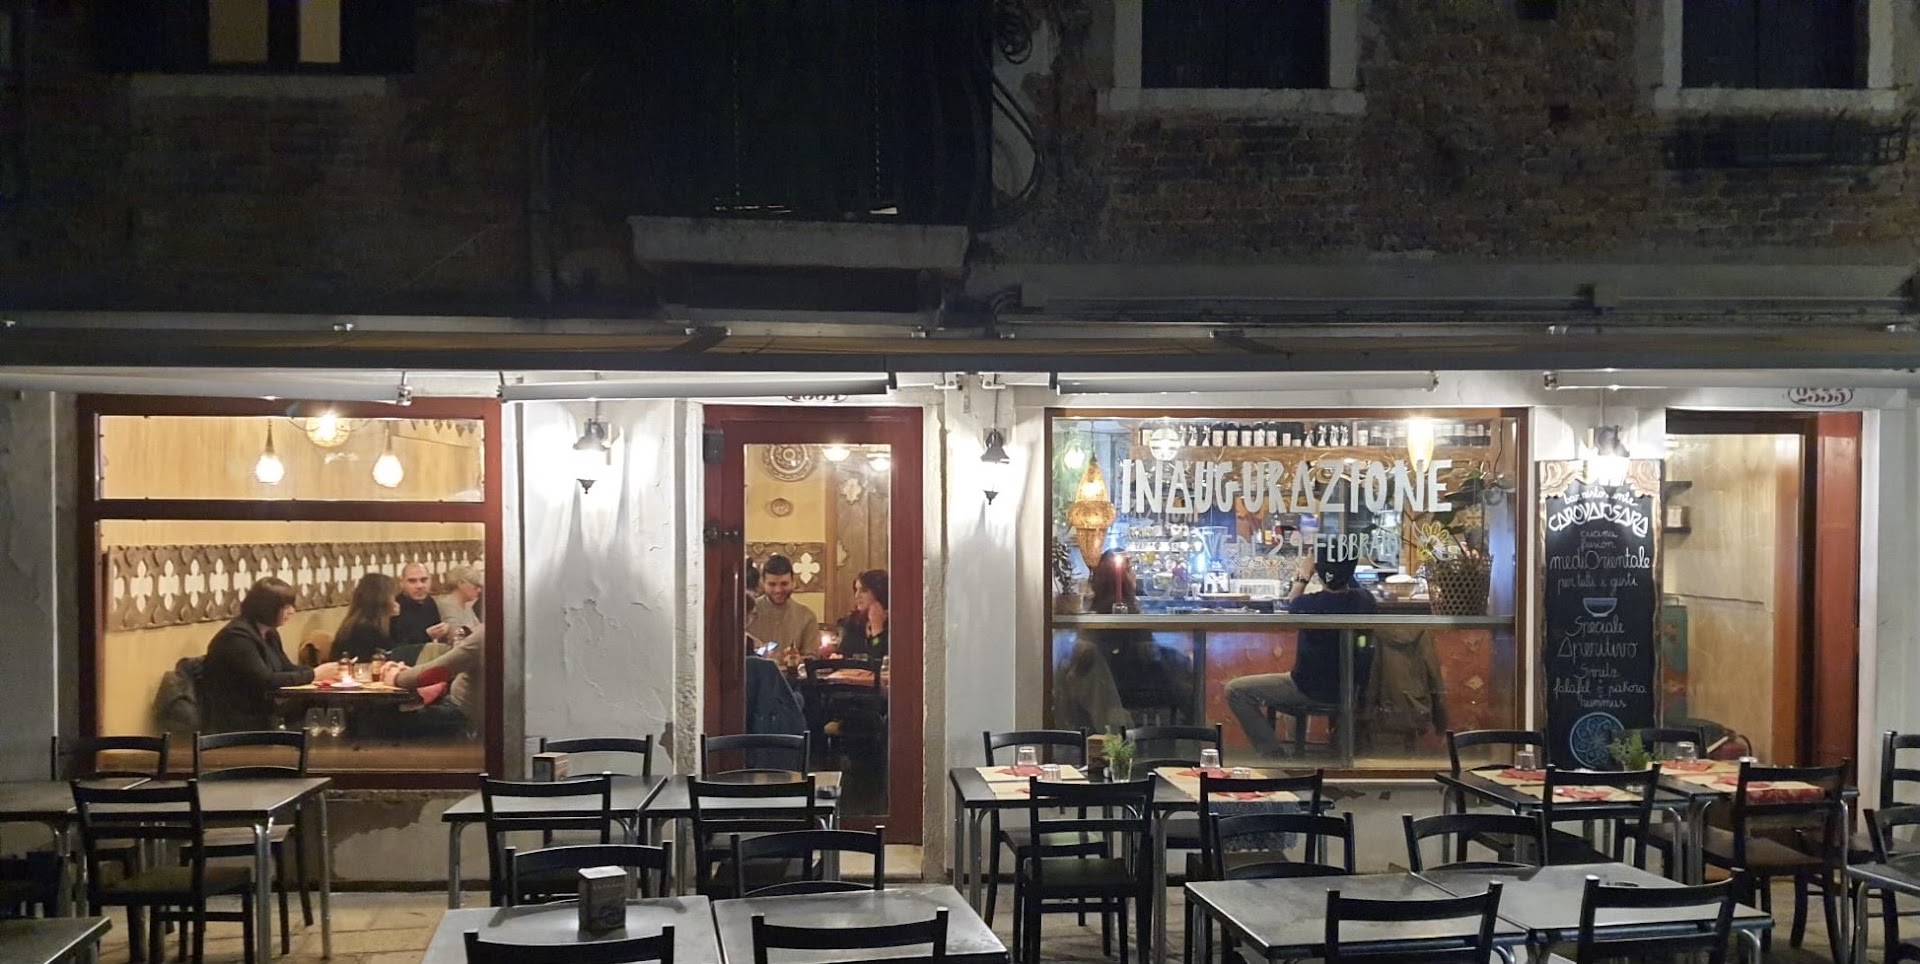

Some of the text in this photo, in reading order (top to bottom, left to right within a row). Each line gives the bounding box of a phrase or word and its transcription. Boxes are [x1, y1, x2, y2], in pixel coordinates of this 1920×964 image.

[1121, 458, 1453, 515] INAUGURAZIONE
[1313, 532, 1399, 563] FEBBRAIO
[1565, 614, 1625, 638] Speciale
[1557, 636, 1639, 665] Aperitivo
